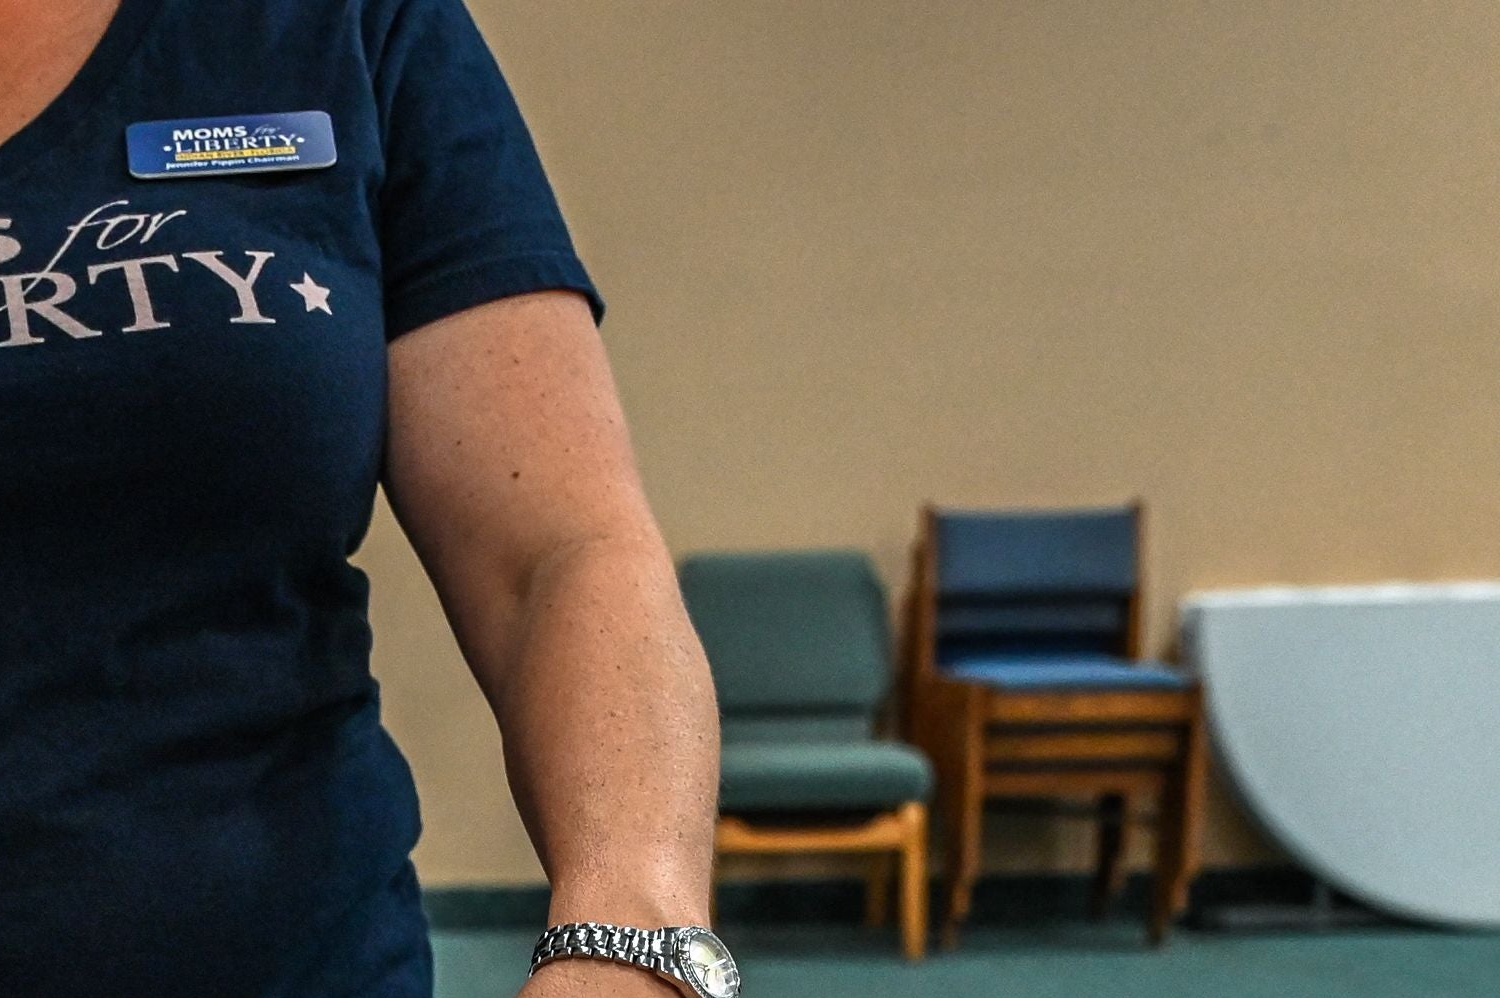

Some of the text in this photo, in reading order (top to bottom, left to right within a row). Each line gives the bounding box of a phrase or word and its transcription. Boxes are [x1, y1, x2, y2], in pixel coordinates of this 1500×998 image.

[172, 126, 247, 141] MOMS
[175, 133, 296, 153] LIBERTY
[166, 159, 209, 170] Jennifer
[212, 157, 245, 168] Pippin
